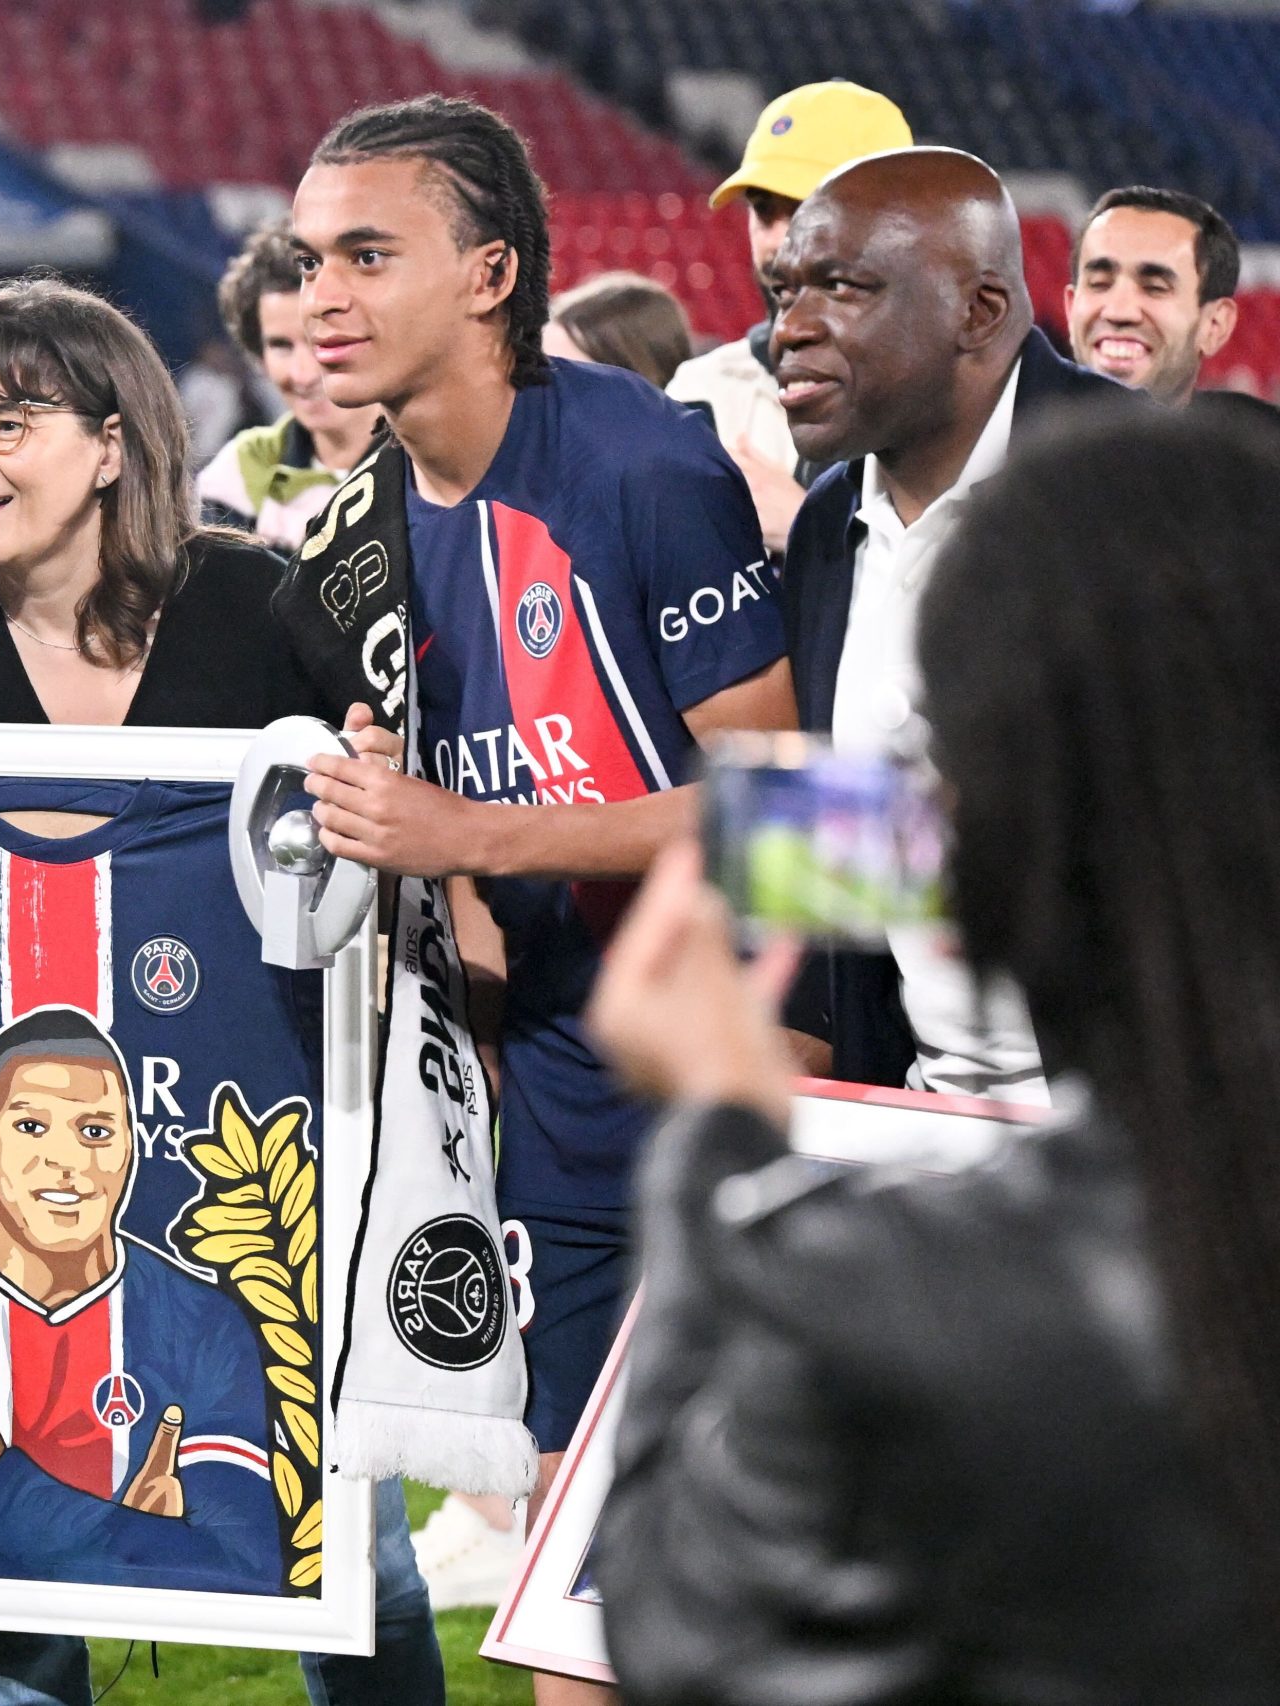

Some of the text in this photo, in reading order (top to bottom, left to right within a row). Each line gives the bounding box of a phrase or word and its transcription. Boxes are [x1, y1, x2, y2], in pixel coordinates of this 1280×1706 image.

[523, 586, 553, 608] PARIS
[660, 560, 770, 642] GOAT
[143, 942, 187, 961] PARIS
